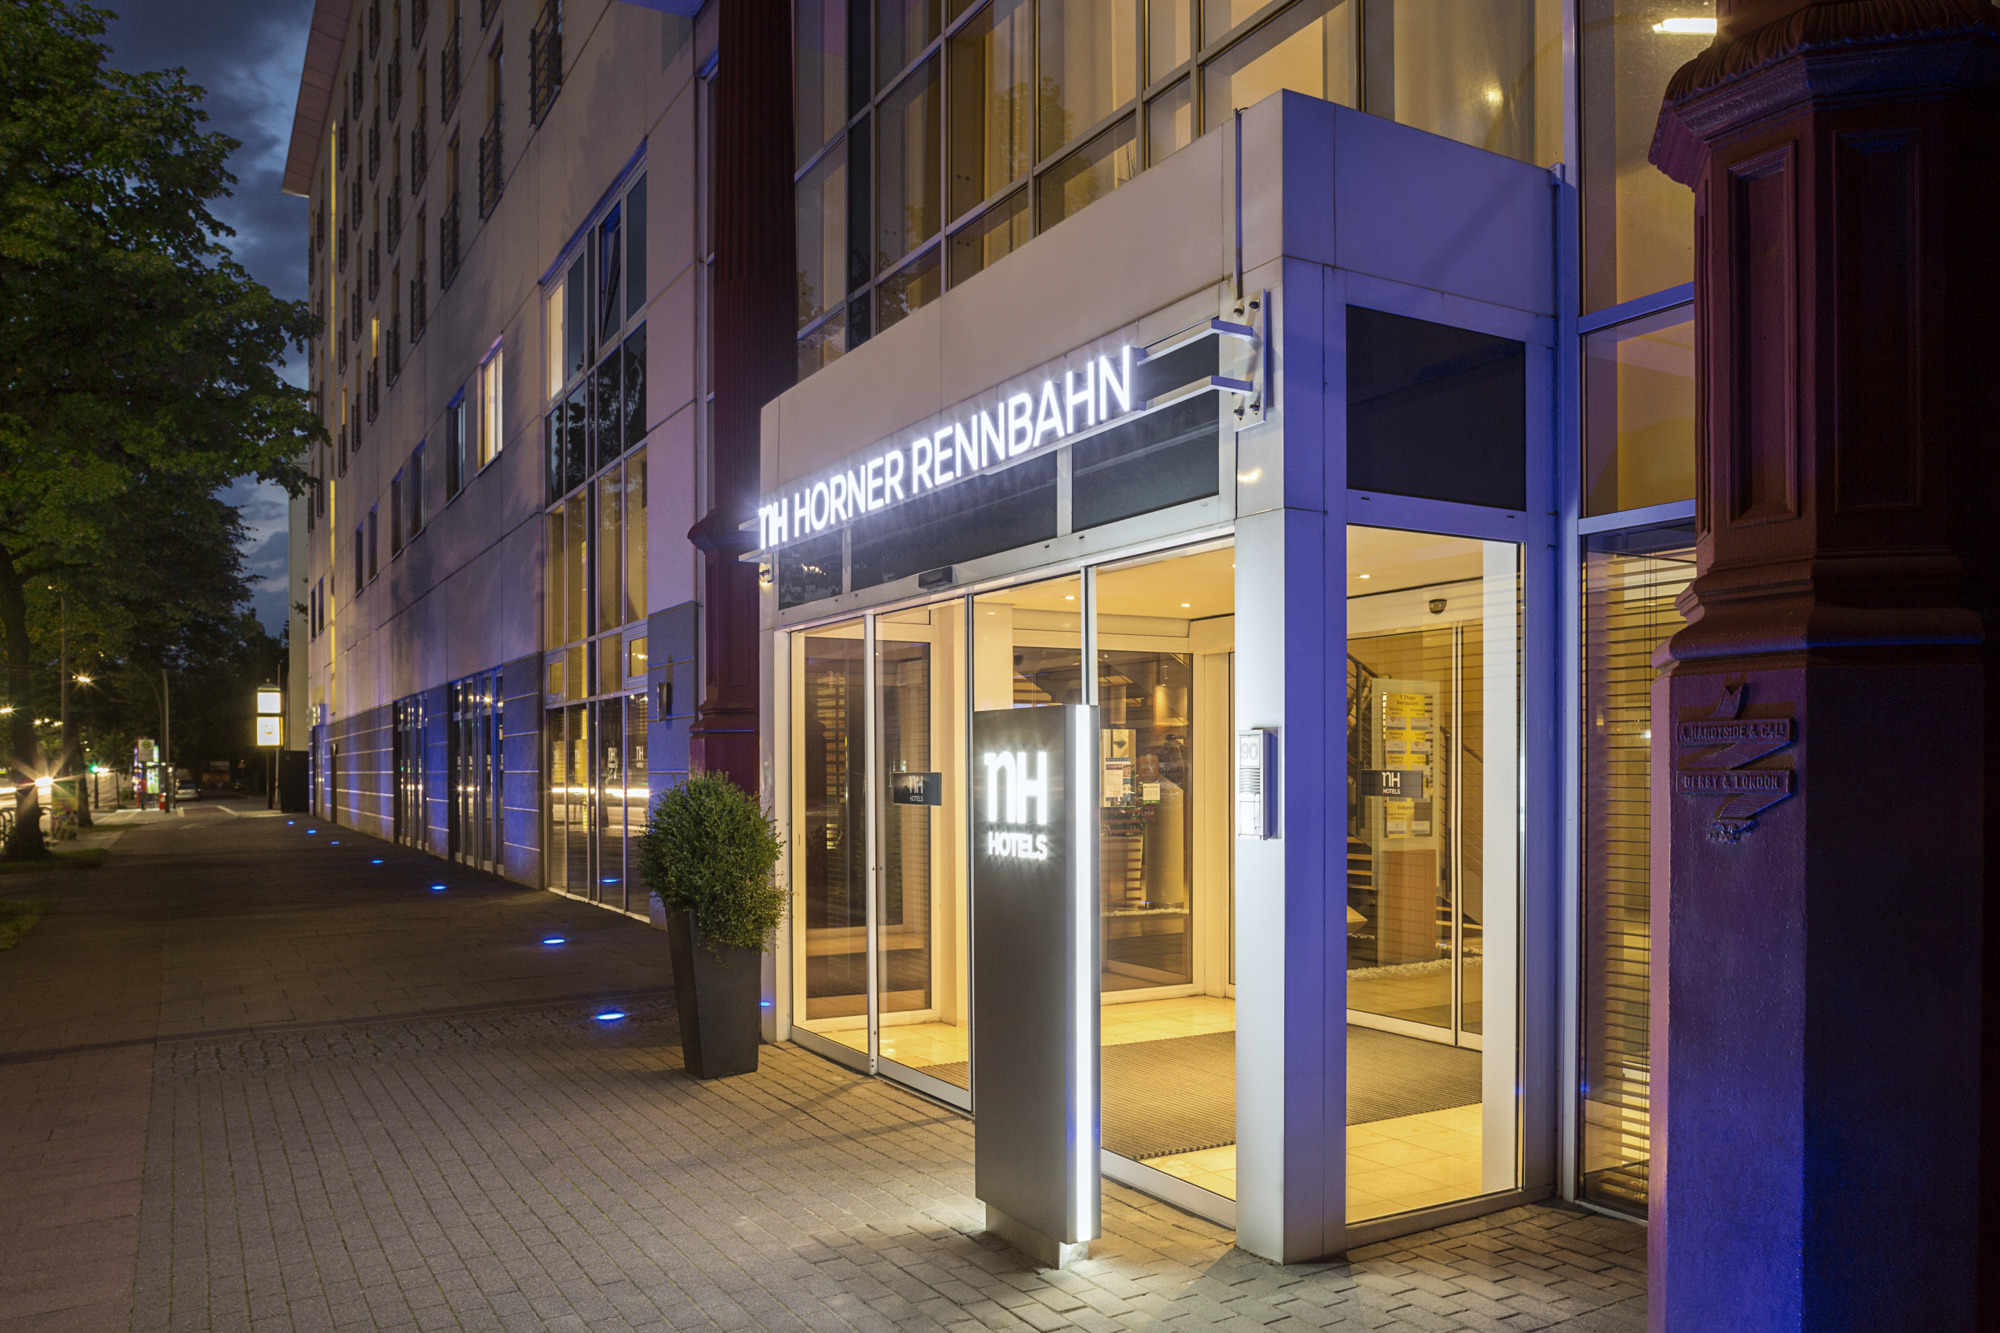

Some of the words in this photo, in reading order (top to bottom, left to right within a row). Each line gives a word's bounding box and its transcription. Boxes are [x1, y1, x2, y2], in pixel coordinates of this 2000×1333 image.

[794, 450, 904, 539] HORNER
[912, 346, 1131, 490] RENNBAHN
[1241, 743, 1258, 760] 90
[1684, 775, 1717, 789] DERBY
[1735, 775, 1779, 789] LONDON
[988, 831, 1047, 860] HOTELS
